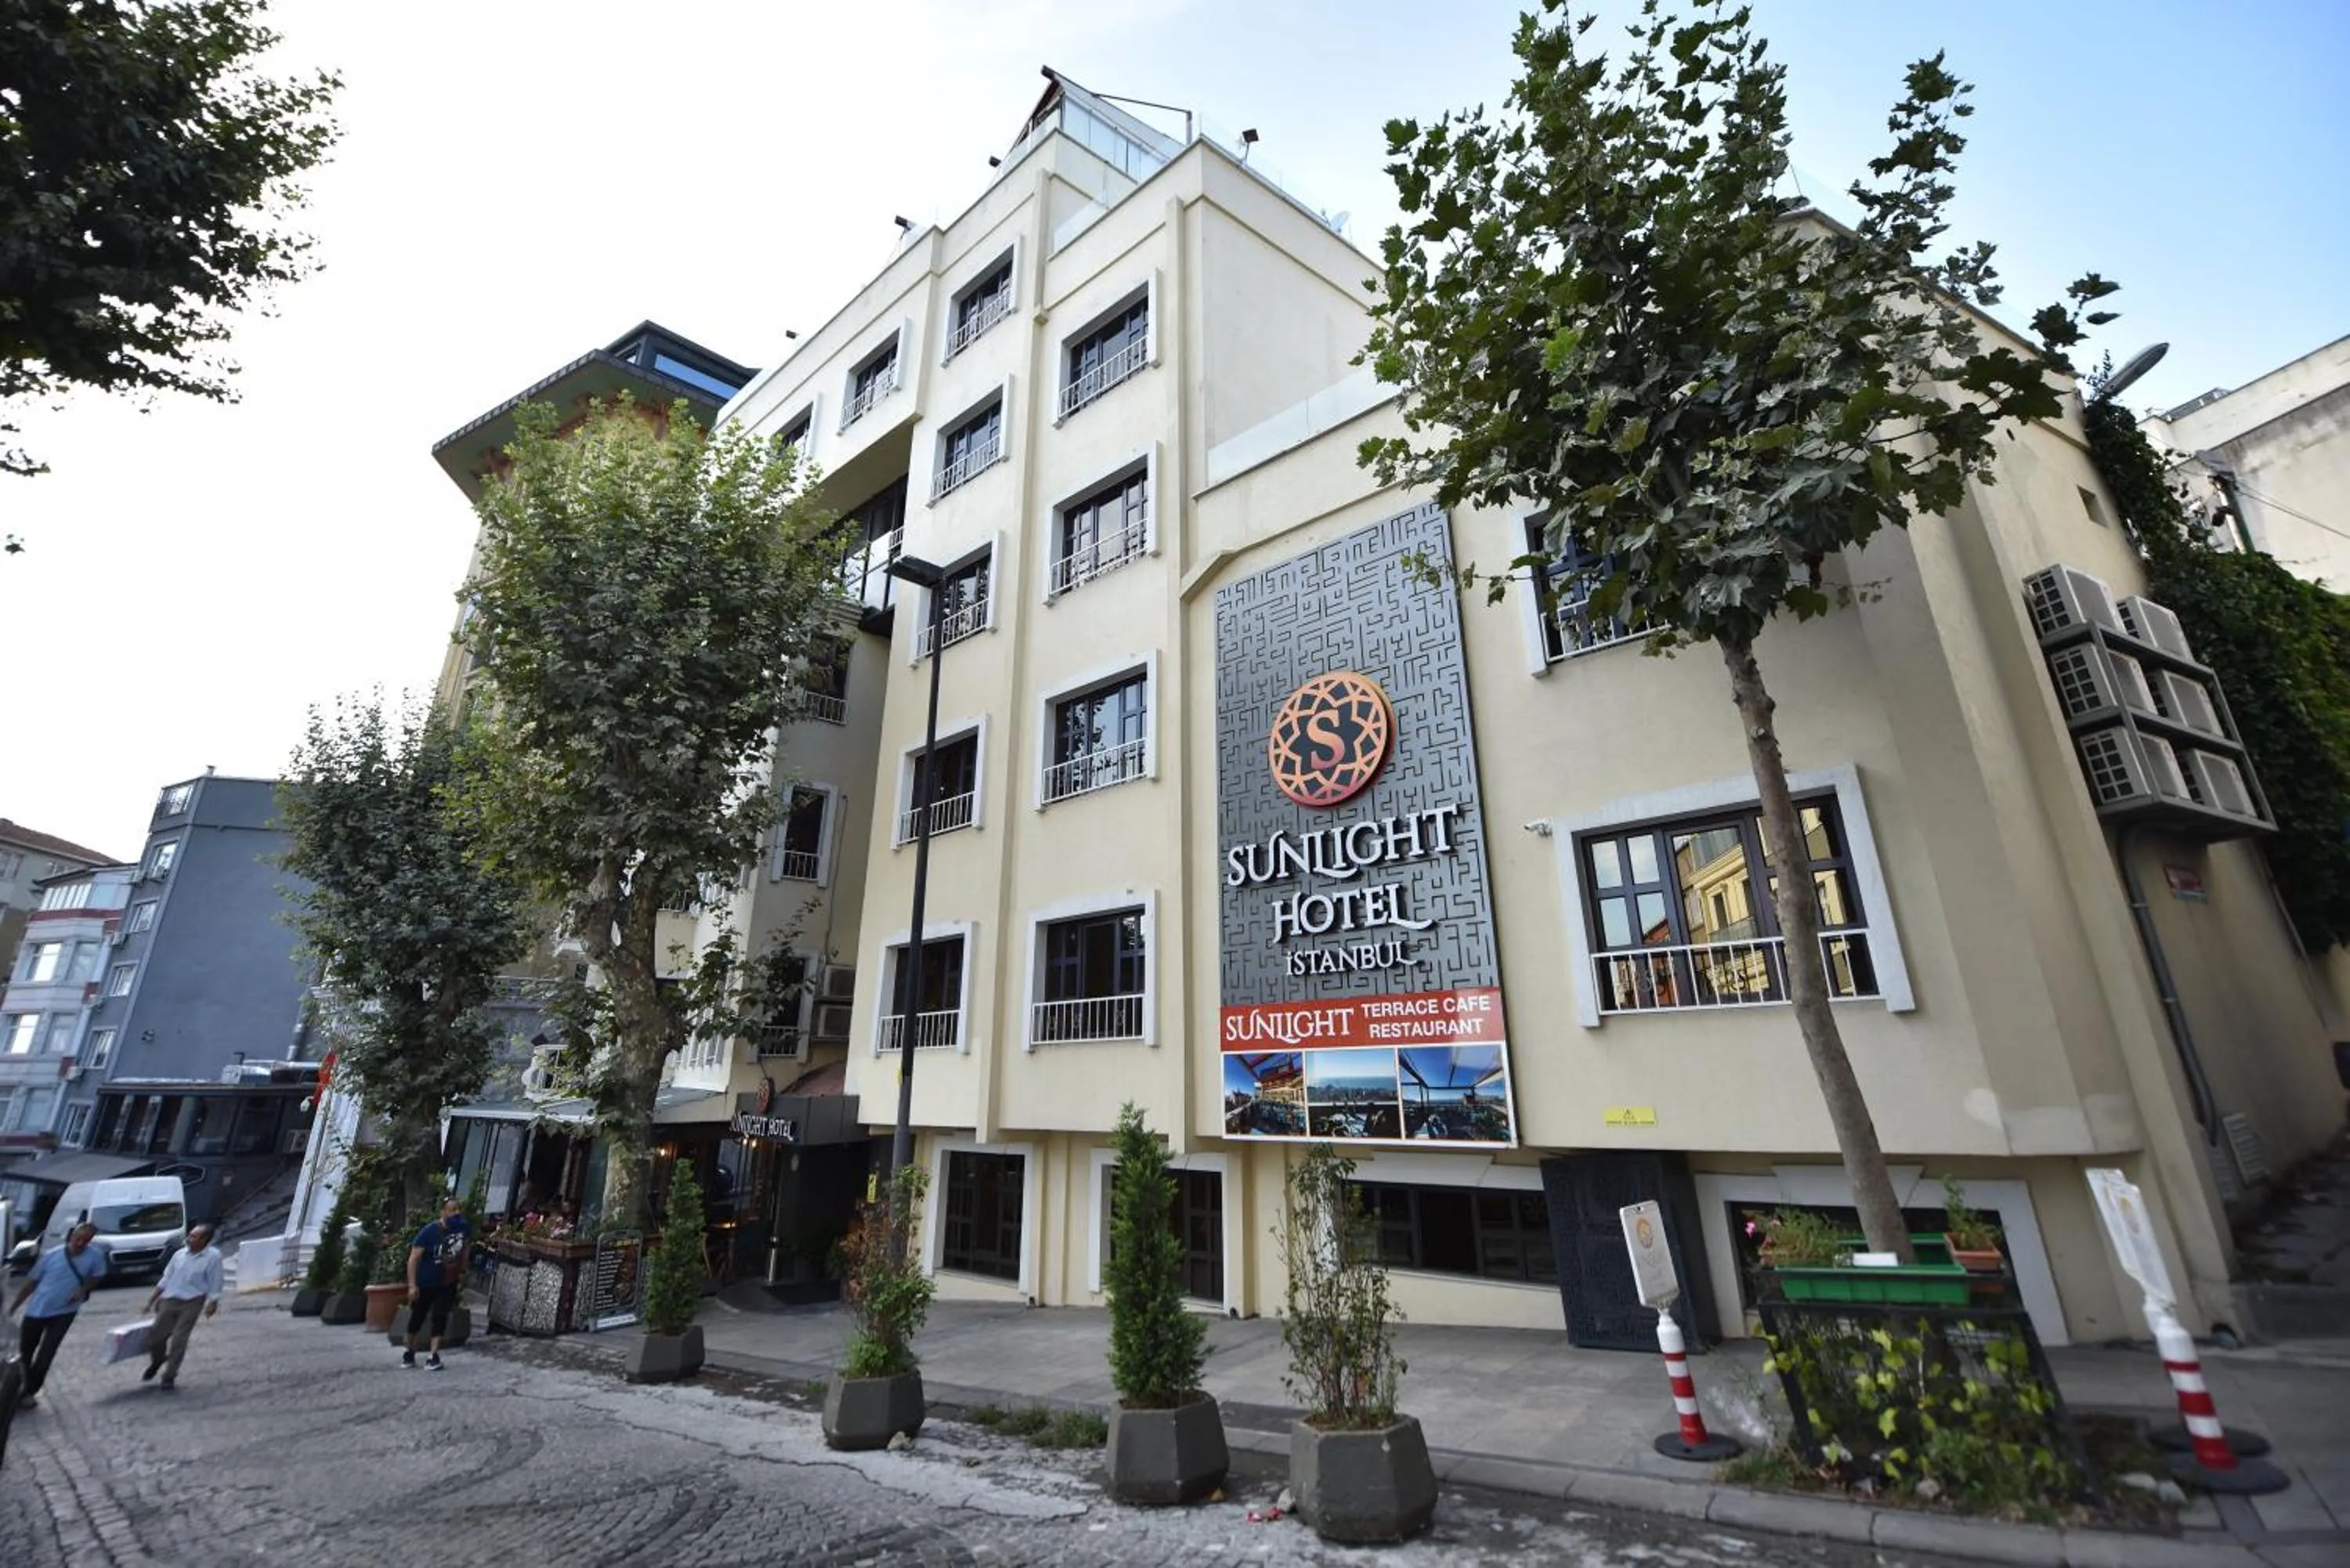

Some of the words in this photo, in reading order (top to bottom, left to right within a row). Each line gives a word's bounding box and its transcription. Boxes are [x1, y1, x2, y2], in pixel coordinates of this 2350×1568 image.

[1306, 708, 1346, 769] S
[1227, 805, 1459, 886] SUNLIGHT
[1271, 883, 1434, 944] HOTEL
[1226, 1008, 1354, 1043] SUNLIGHT
[1361, 998, 1439, 1018] TERRACE
[1444, 995, 1491, 1013] CAFE
[1369, 1018, 1484, 1039] RESTAURANT
